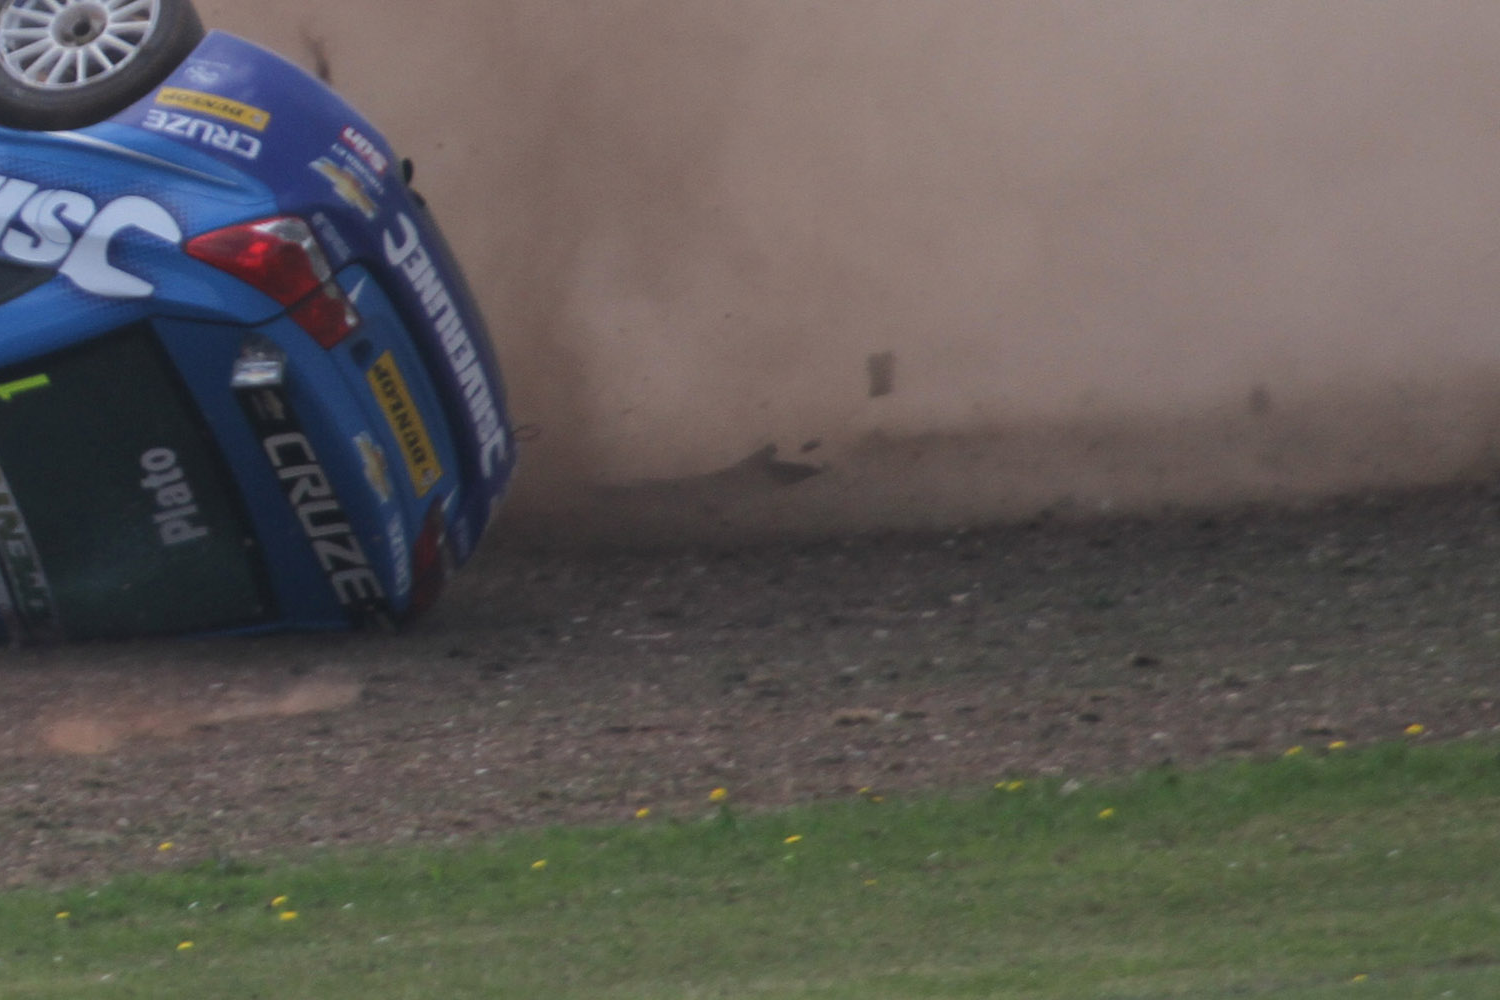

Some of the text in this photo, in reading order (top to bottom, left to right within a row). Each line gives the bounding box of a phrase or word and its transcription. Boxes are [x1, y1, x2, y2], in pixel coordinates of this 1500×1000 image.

[142, 109, 262, 160] CRUZE
[402, 245, 498, 443] SILVERLINE
[373, 363, 428, 466] DUNLOP
[140, 446, 208, 546] Plato
[264, 432, 386, 604] CRUZE
